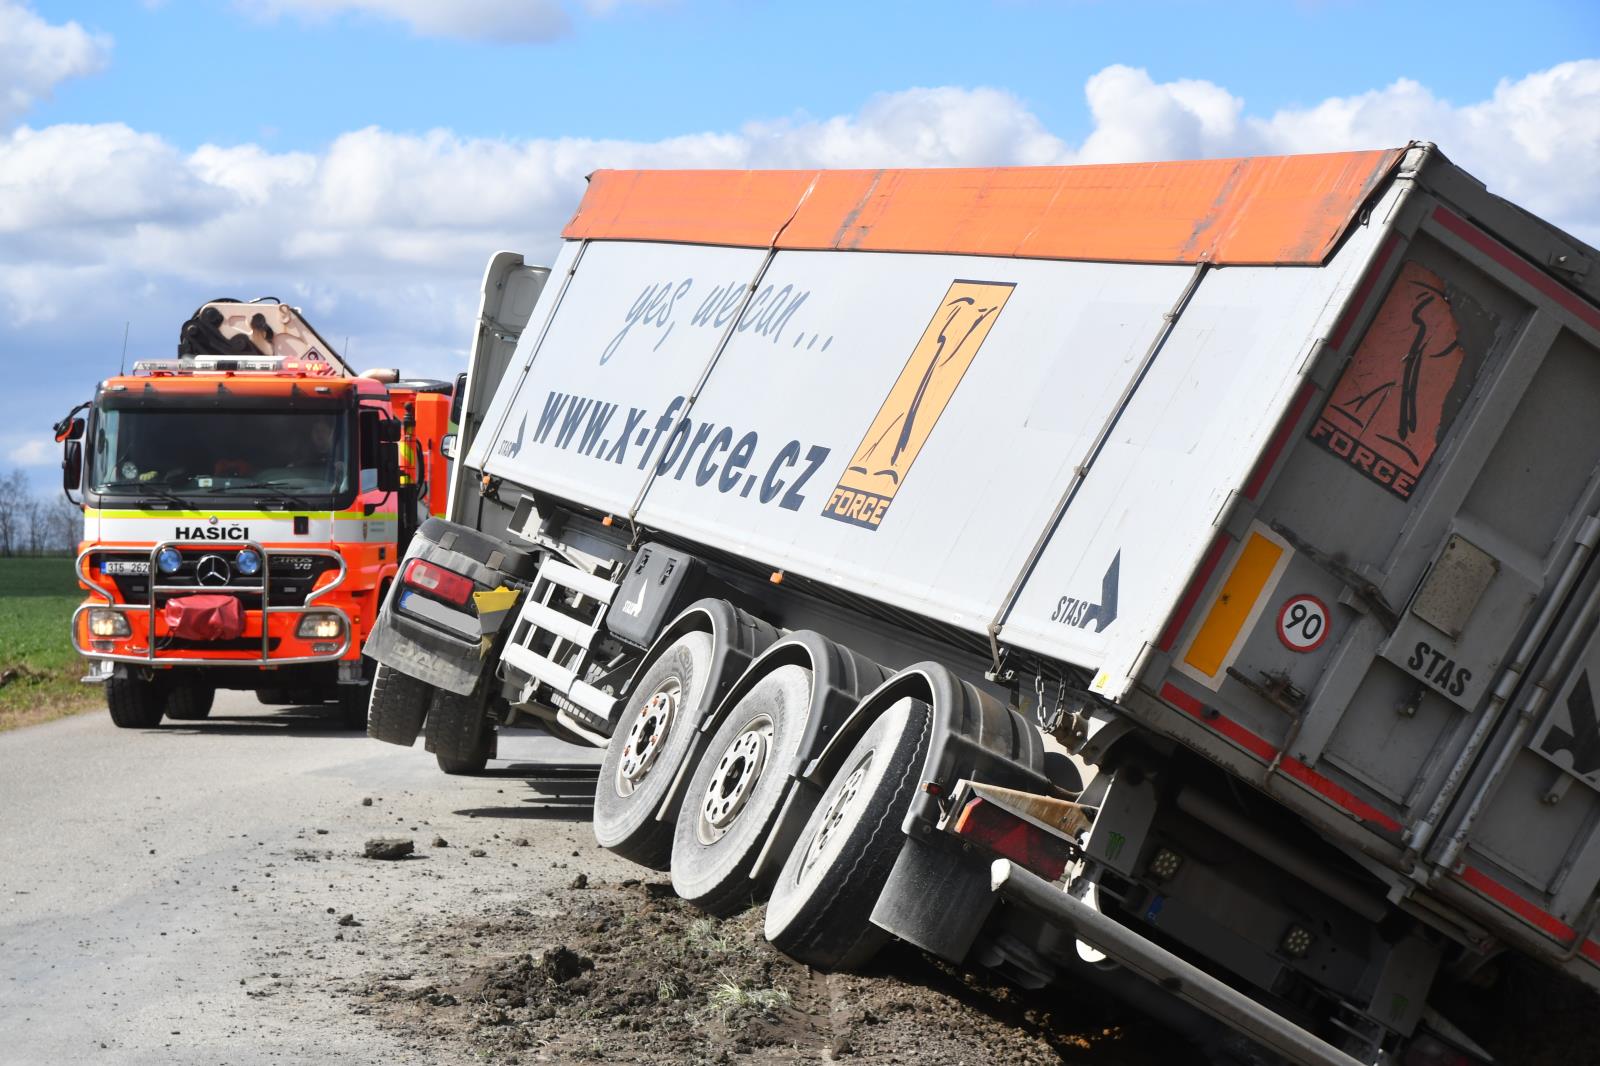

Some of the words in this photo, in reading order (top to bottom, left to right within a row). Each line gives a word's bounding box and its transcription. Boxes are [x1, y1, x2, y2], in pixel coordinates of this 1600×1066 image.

[600, 278, 693, 366] yes,
[690, 281, 747, 328] we
[532, 391, 832, 512] www.x-force.cz
[1311, 420, 1416, 497] FORCE
[825, 488, 890, 525] FORCE
[175, 523, 249, 540] HASIČI
[1051, 595, 1088, 626] STAS
[1285, 604, 1322, 639] 90
[1408, 641, 1472, 697] STAS
